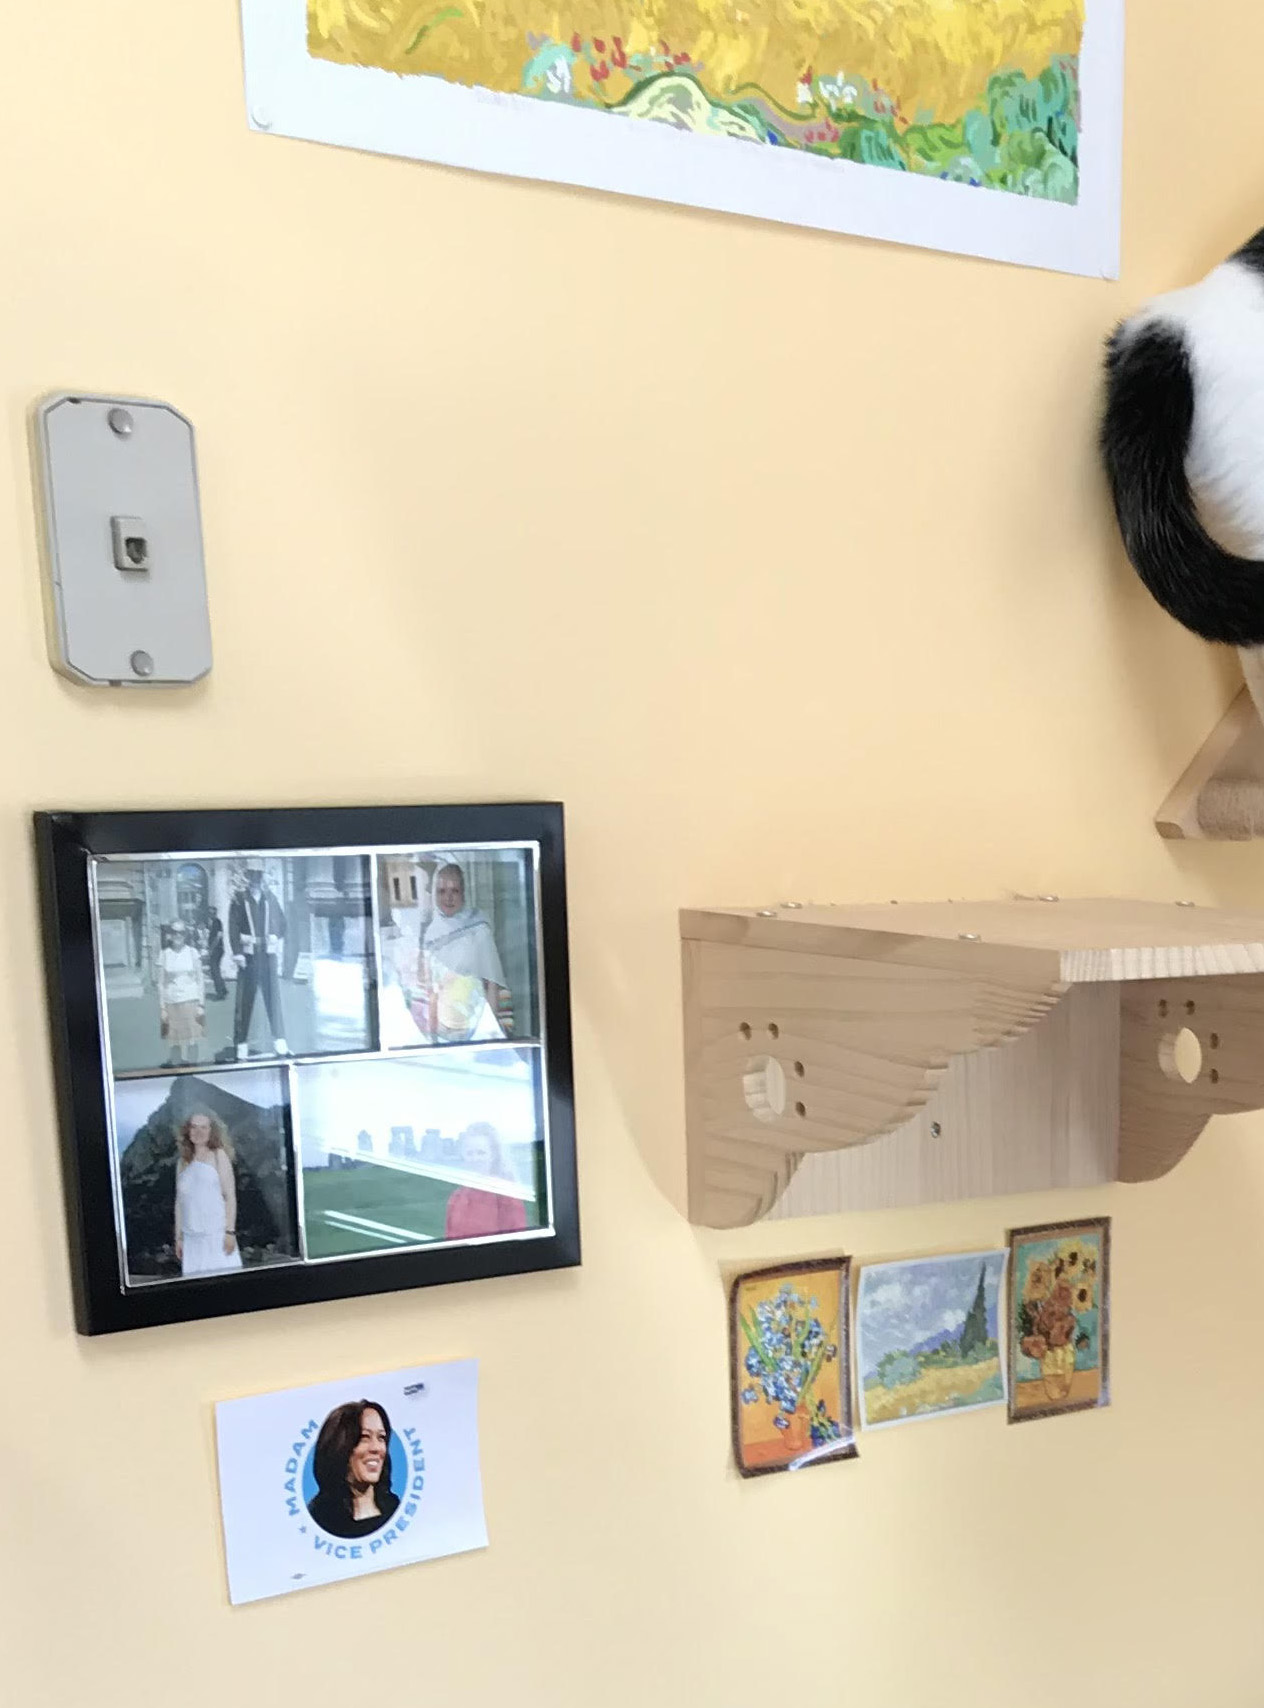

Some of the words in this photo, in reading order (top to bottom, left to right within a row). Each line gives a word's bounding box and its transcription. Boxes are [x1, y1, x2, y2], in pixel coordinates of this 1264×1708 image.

[284, 1419, 318, 1516] MADAM
[314, 1535, 363, 1559] VICE
[369, 1427, 425, 1554] PRESIDENT
